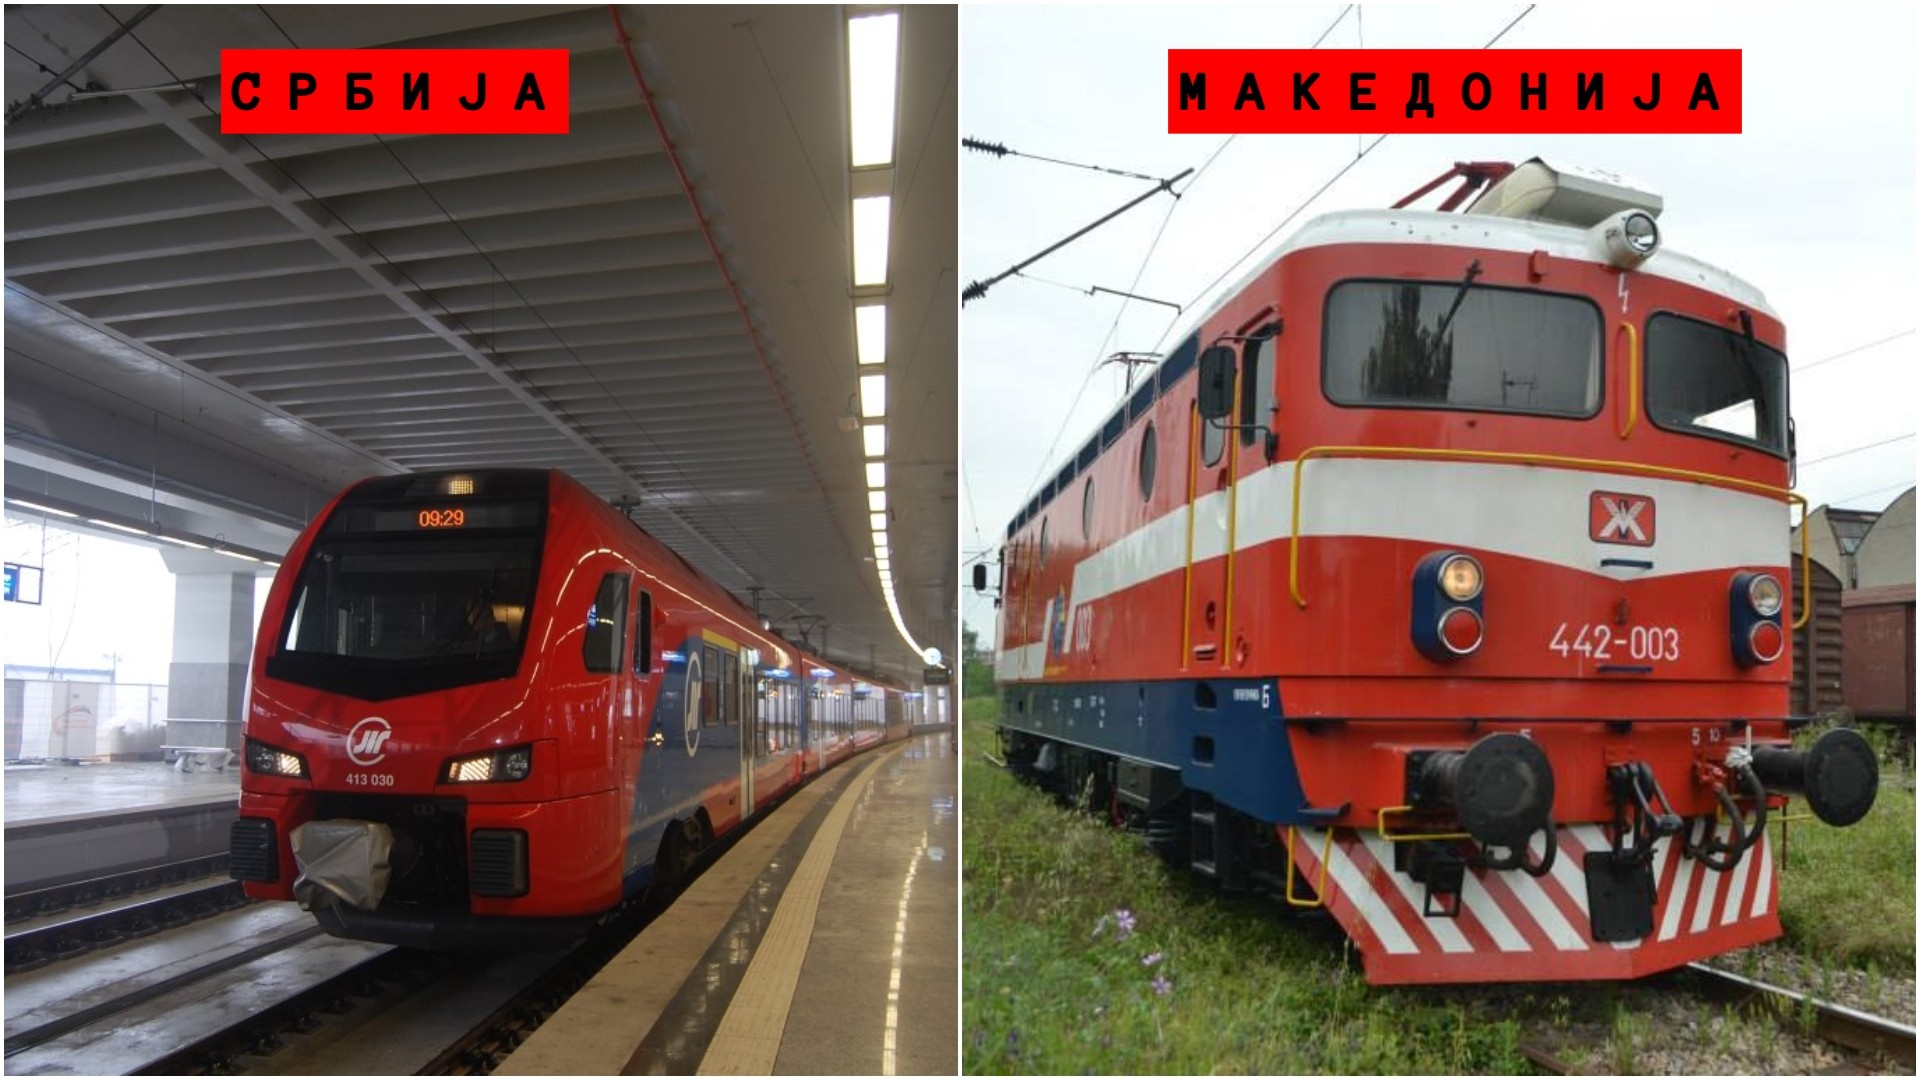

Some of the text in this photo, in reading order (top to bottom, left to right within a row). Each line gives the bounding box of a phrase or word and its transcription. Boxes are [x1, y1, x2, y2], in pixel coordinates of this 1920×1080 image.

[419, 510, 464, 527] 09:29
[1549, 623, 1679, 661] 442-003
[346, 773, 394, 786] 413 030
